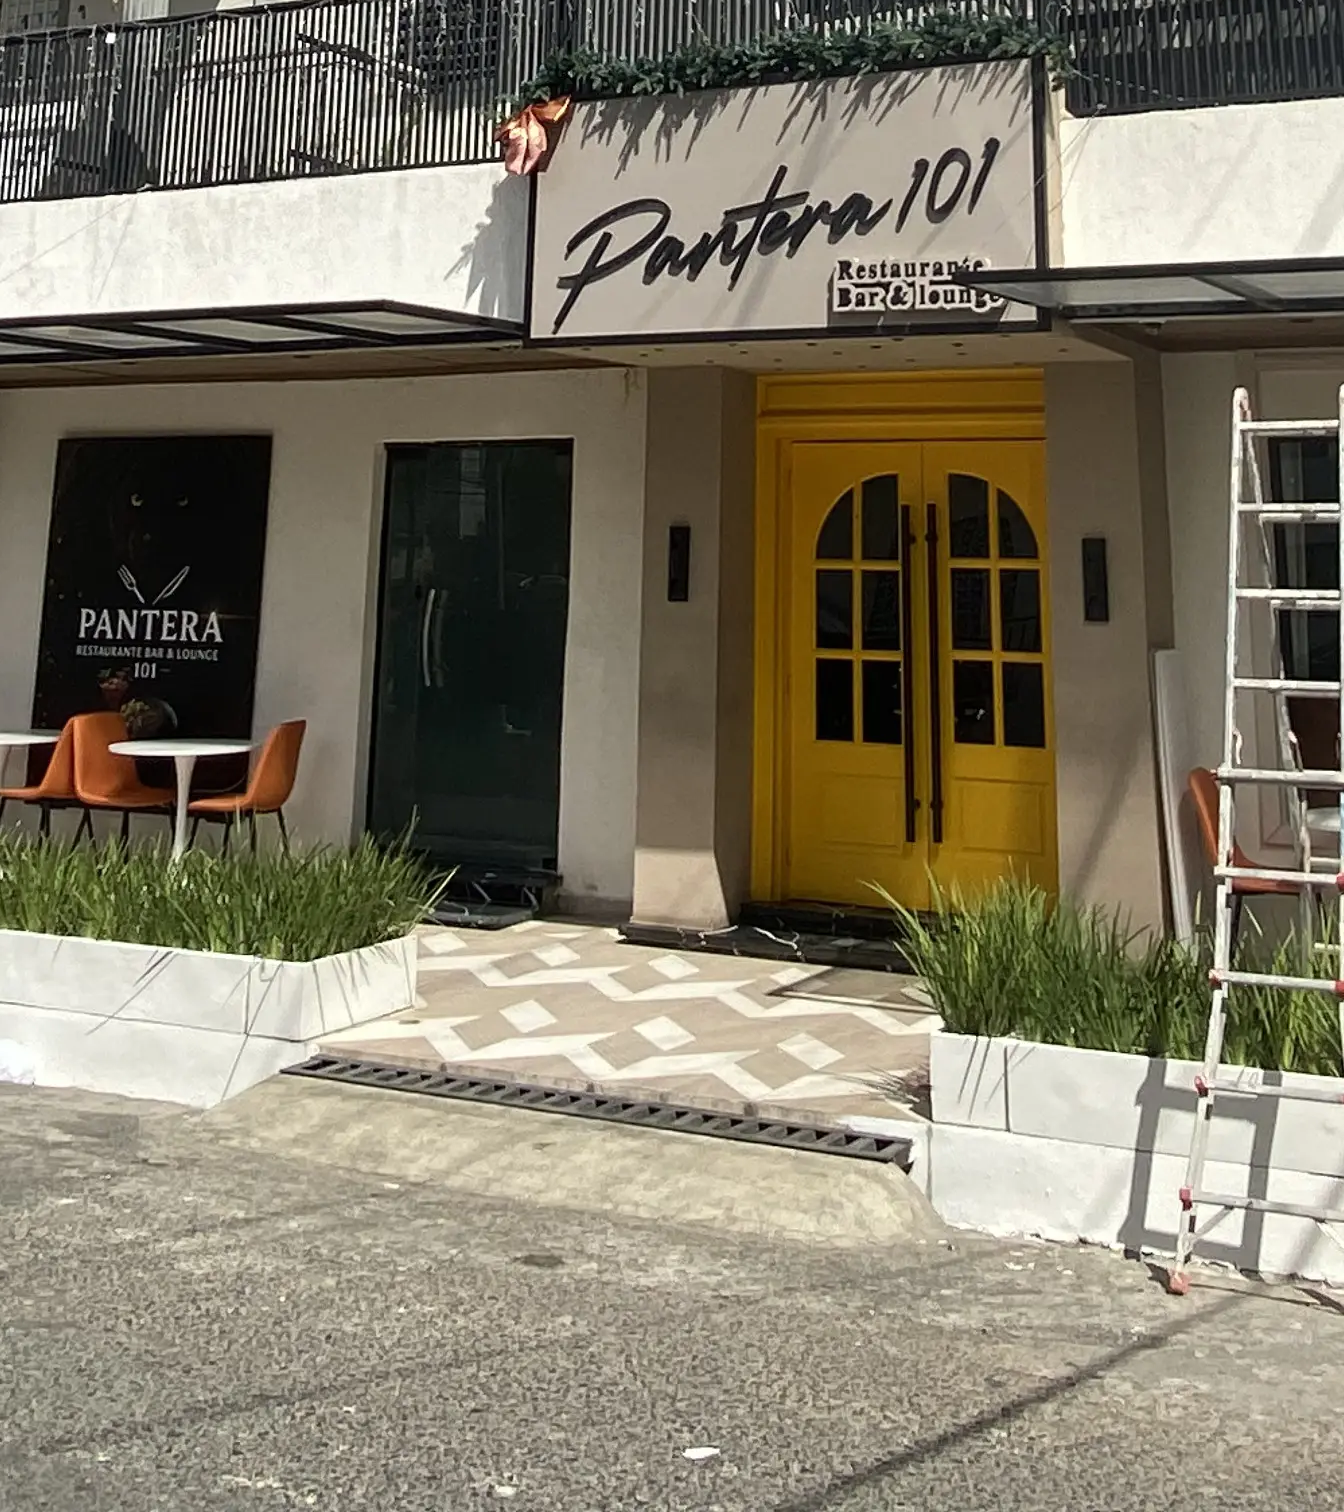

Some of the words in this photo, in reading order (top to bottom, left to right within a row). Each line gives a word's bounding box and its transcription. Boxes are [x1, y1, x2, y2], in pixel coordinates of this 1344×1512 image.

[553, 164, 893, 335] Pantera
[895, 136, 1001, 234] 101
[837, 287, 880, 308] Bar
[890, 285, 909, 307] &
[78, 607, 224, 643] PANTERA
[75, 644, 143, 659] RESTAURANTE
[144, 646, 164, 659] BAR
[176, 648, 218, 662] LOUNGE
[134, 661, 157, 679] 101
